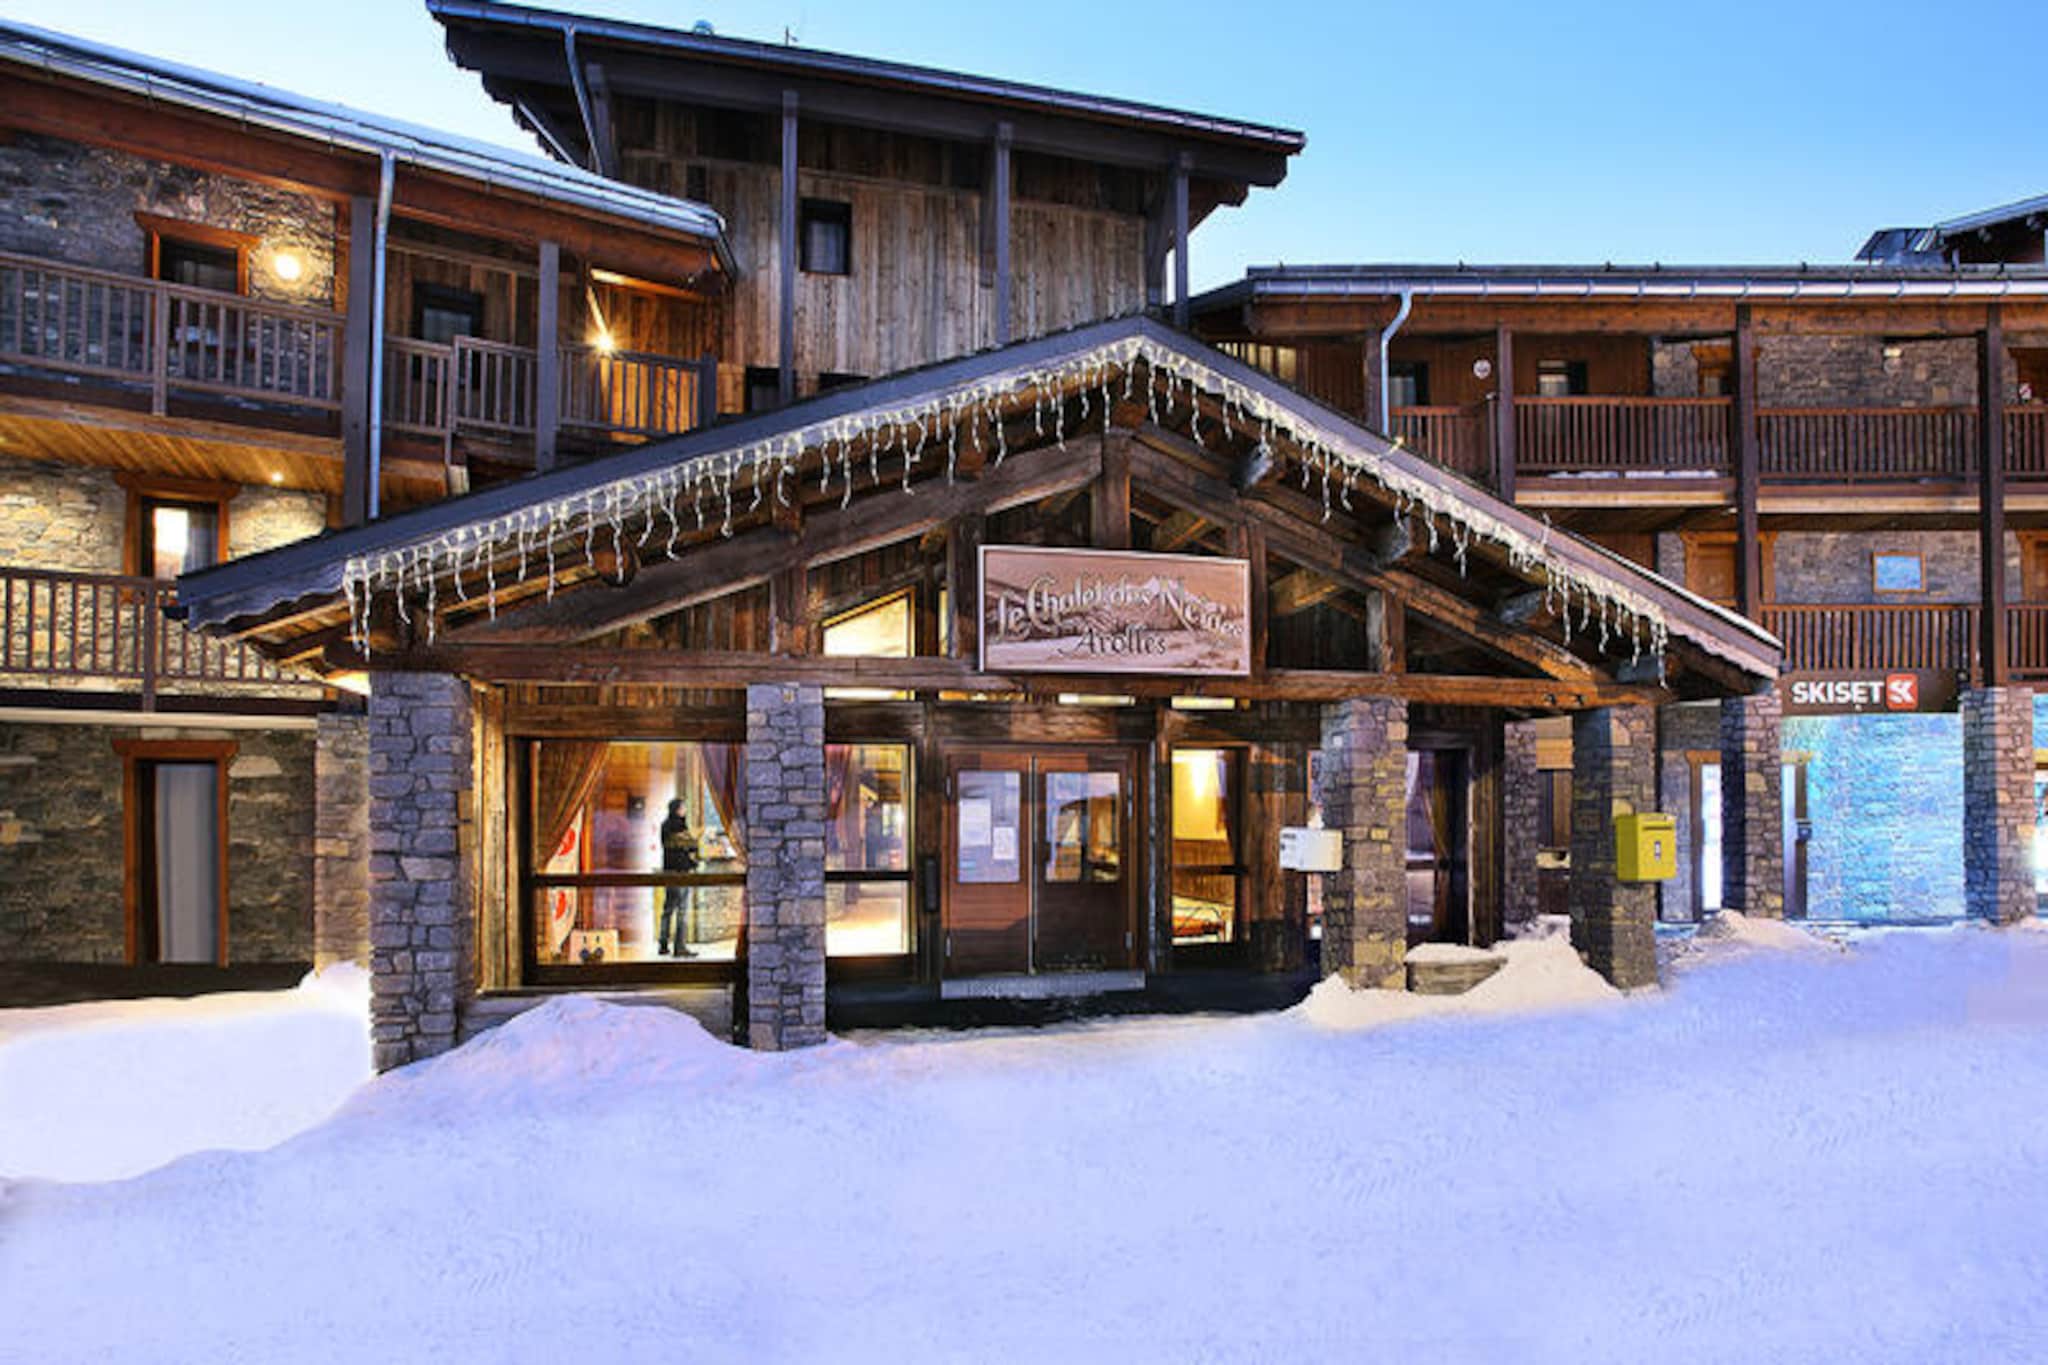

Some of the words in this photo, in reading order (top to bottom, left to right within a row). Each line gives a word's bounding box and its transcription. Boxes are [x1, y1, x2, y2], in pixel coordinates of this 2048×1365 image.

[994, 588, 1031, 642] Le
[1026, 573, 1104, 635] Chalet
[1059, 624, 1167, 655] Arolles
[1791, 681, 1885, 704] SKISET
